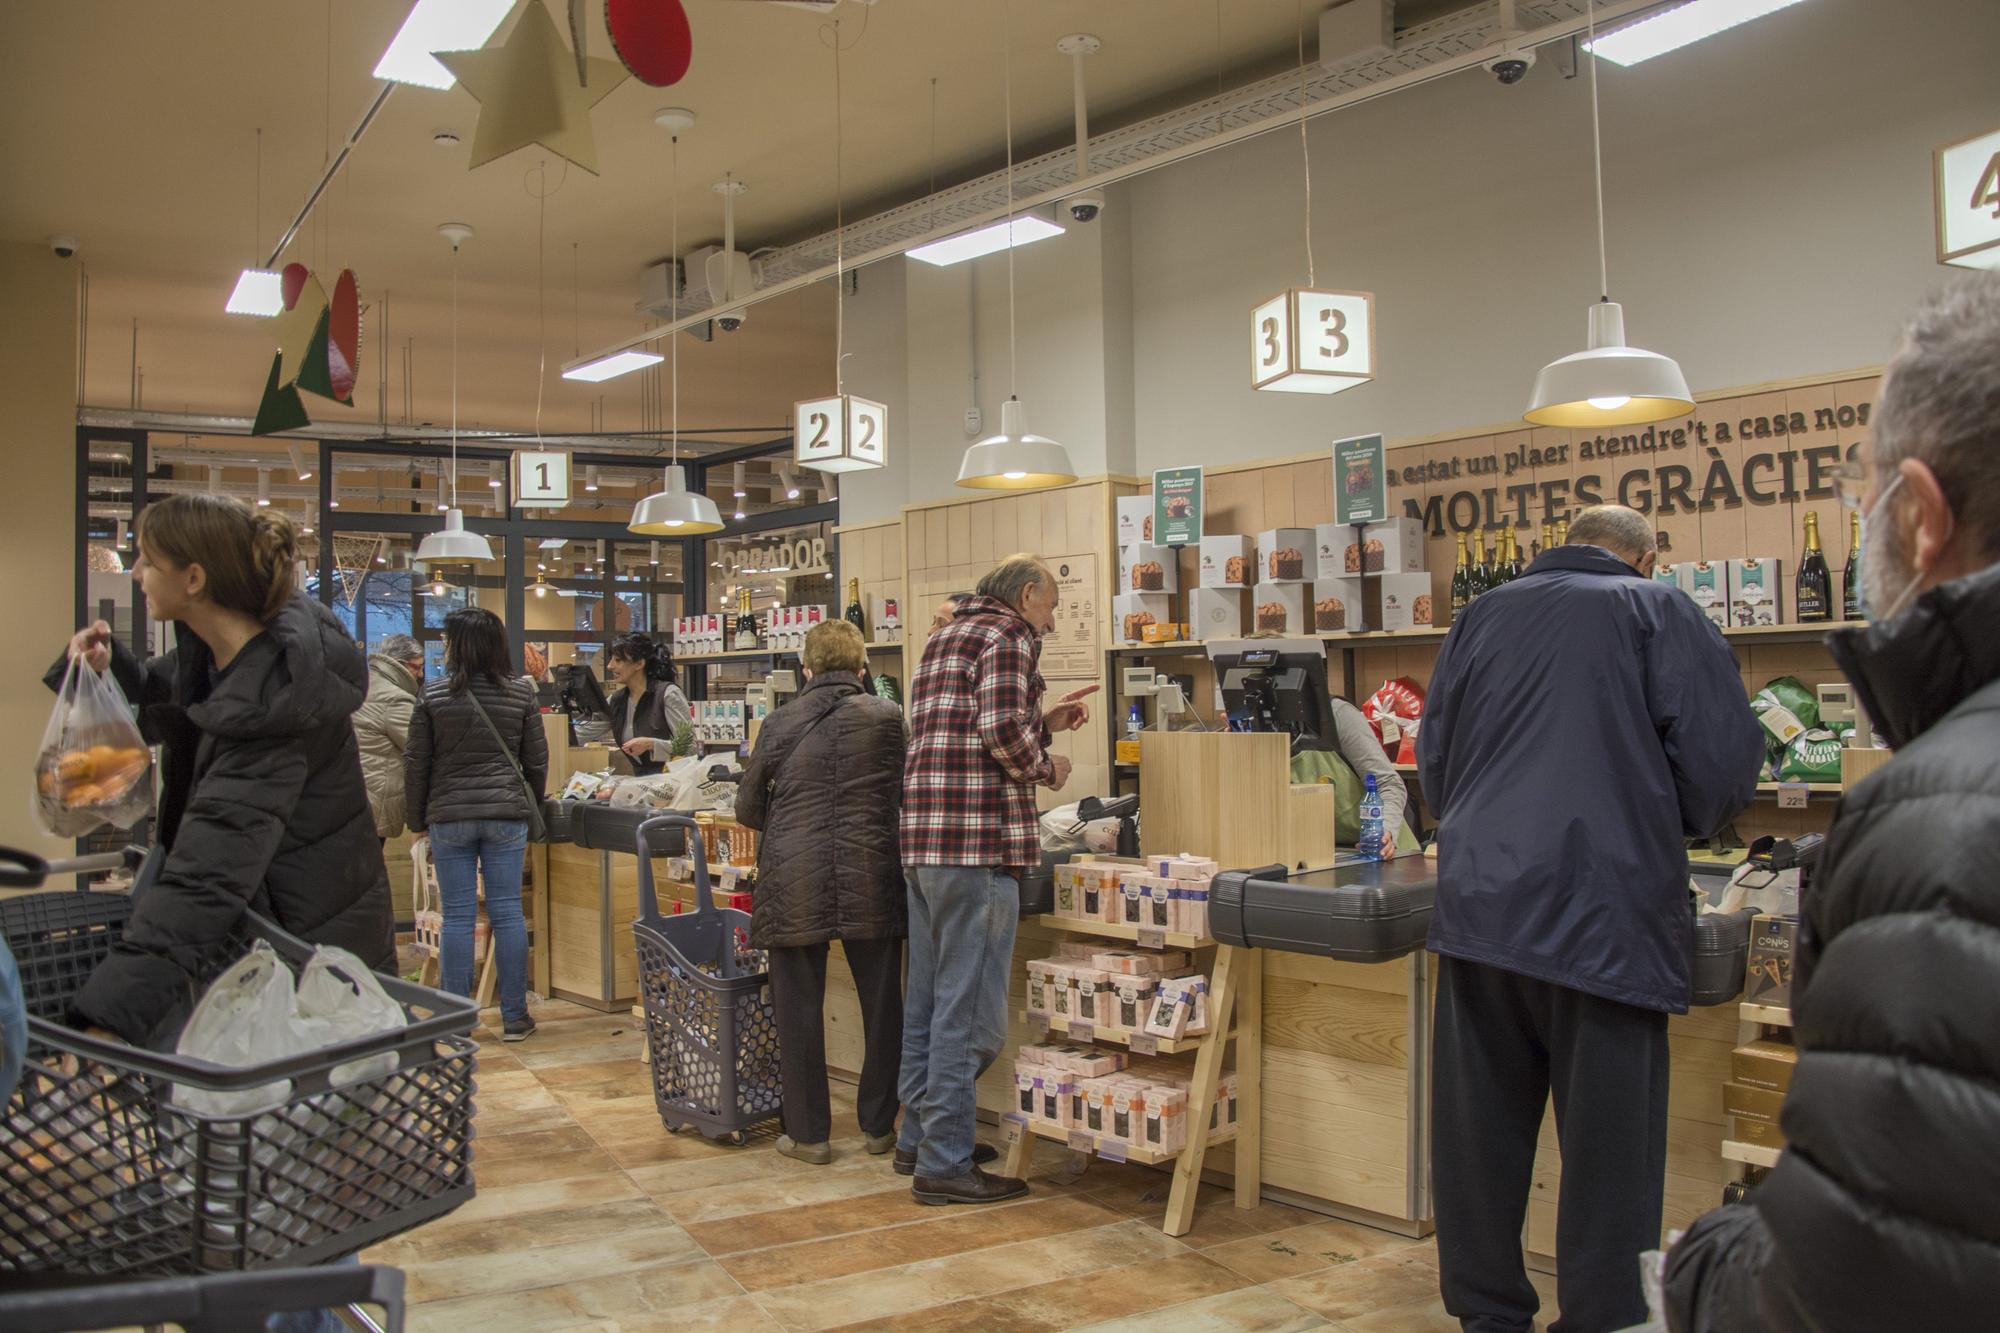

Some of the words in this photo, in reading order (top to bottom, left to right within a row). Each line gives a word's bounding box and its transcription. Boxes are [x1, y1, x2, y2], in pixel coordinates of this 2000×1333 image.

[1262, 317, 1280, 366] 3
[1319, 308, 1349, 358] 3
[809, 413, 830, 449] 2
[859, 414, 876, 451] 2
[1387, 470, 1399, 485] a
[1404, 457, 1460, 482] estat
[1466, 454, 1499, 473] un
[1505, 445, 1570, 475] plaer
[1715, 422, 1732, 442] a
[1739, 411, 1807, 440] casa
[1815, 402, 1872, 429] nos
[535, 462, 551, 490] 1
[1403, 475, 1604, 536] MOLTES
